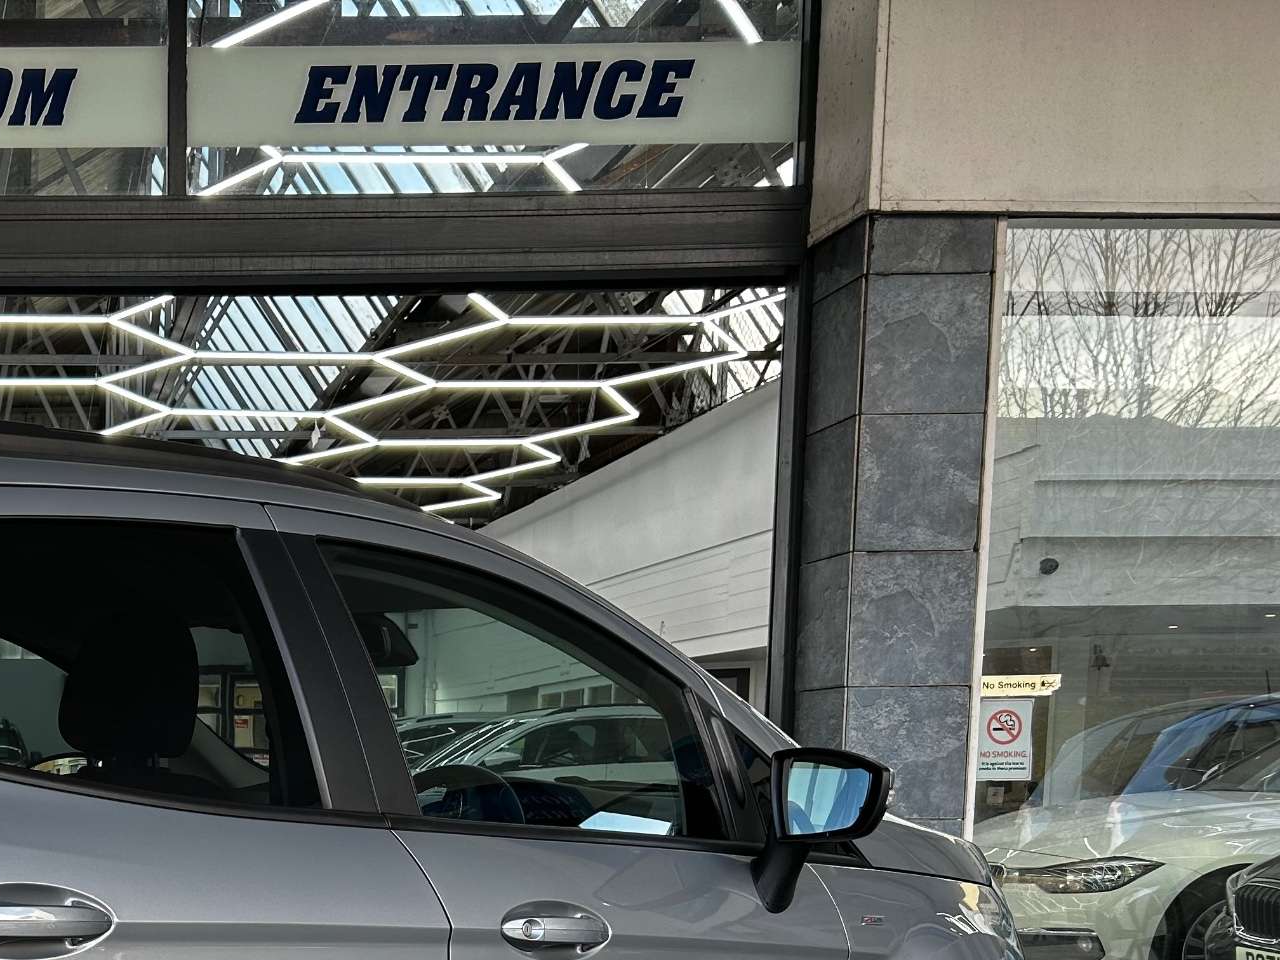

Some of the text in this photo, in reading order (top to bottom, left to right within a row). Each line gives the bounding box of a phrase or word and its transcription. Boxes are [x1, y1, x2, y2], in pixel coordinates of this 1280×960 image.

[294, 59, 696, 124] ENTRANCE
[982, 681, 1036, 690] No Smoking
